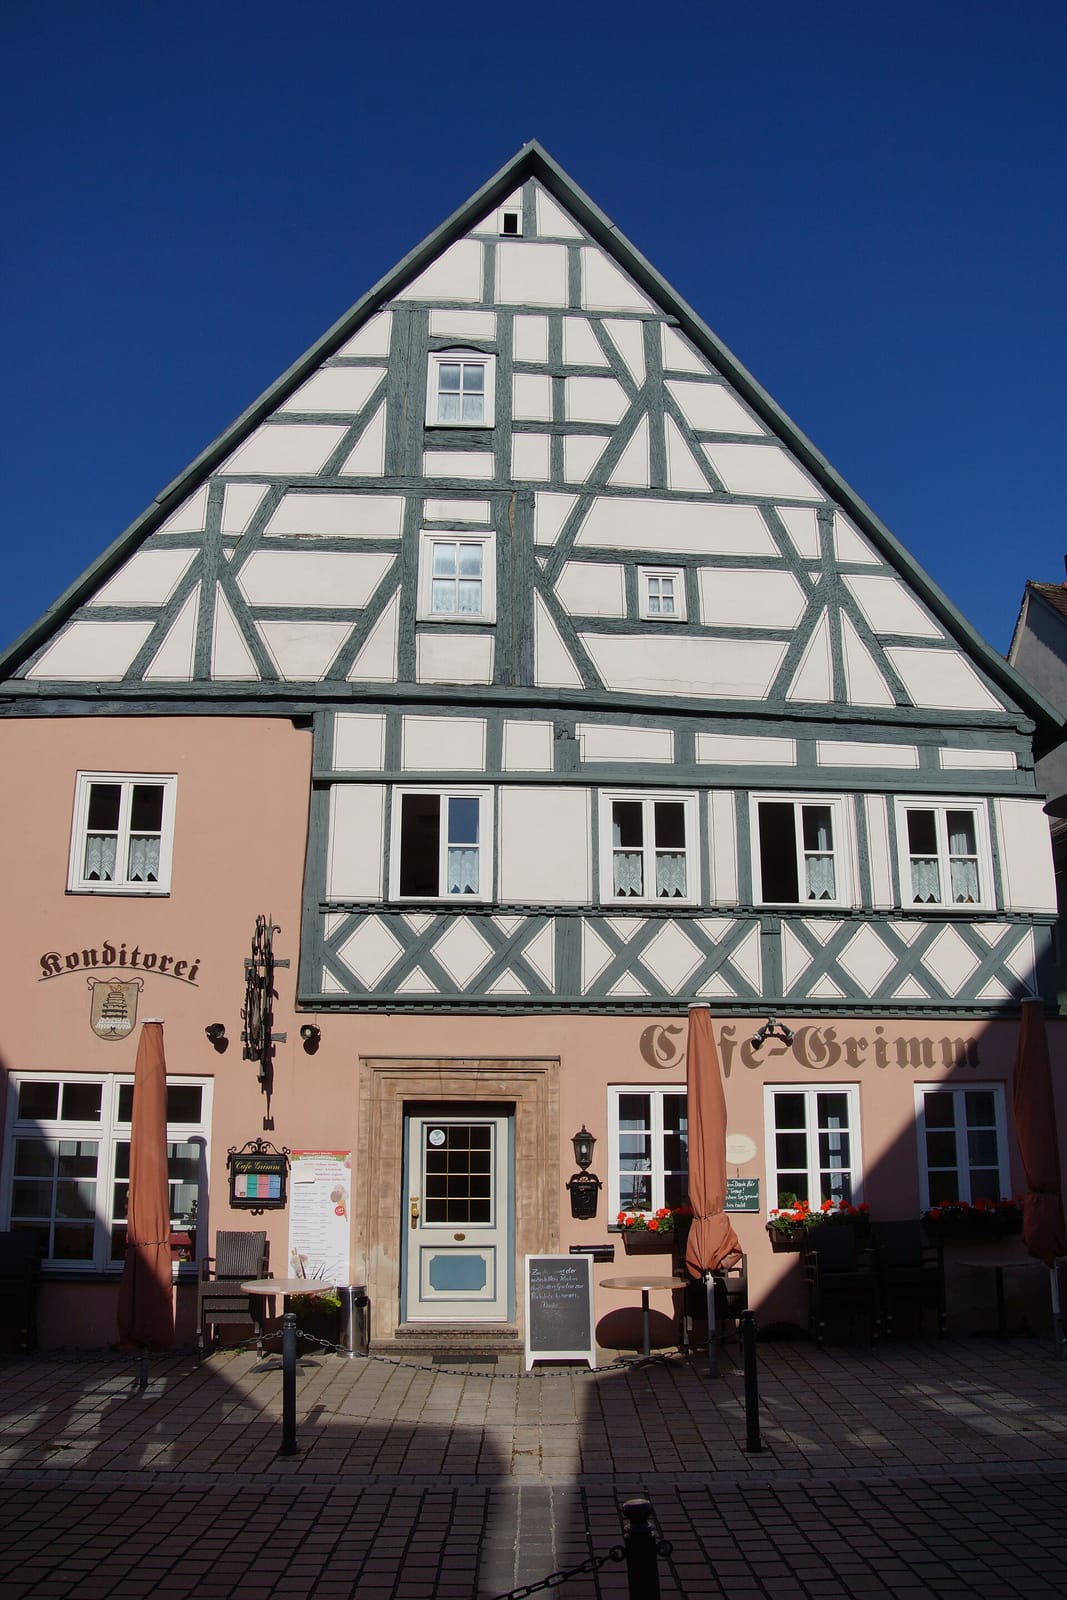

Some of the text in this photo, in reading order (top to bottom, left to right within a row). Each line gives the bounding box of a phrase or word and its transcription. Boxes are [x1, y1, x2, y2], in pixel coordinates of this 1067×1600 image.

[40, 940, 200, 981] Konditorei
[639, 1024, 981, 1079] Cfe-Grimm
[254, 1161, 281, 1170] Grimm
